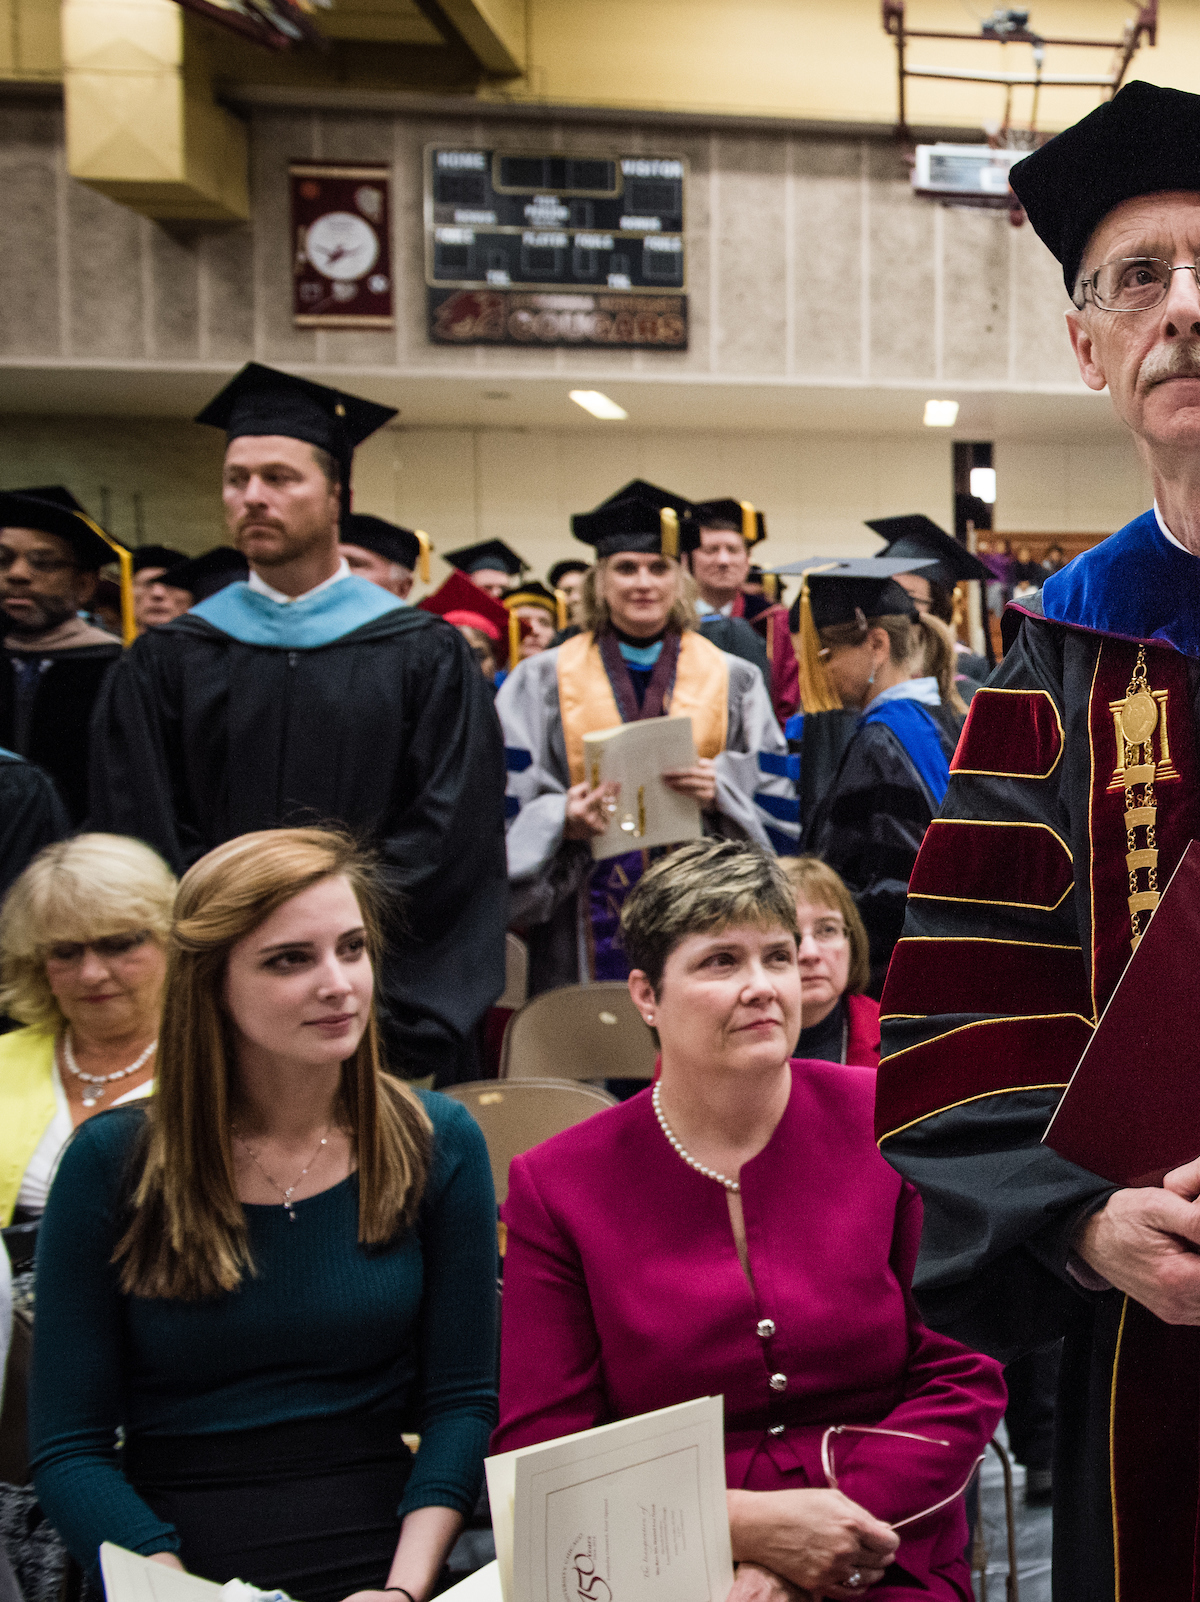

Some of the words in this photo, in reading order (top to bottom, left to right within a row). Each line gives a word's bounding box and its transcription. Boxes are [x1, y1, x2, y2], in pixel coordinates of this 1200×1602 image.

[437, 152, 485, 170] HOME
[621, 160, 683, 178] VISITOR
[507, 309, 686, 344] COUGARS
[572, 1553, 613, 1602] 150
